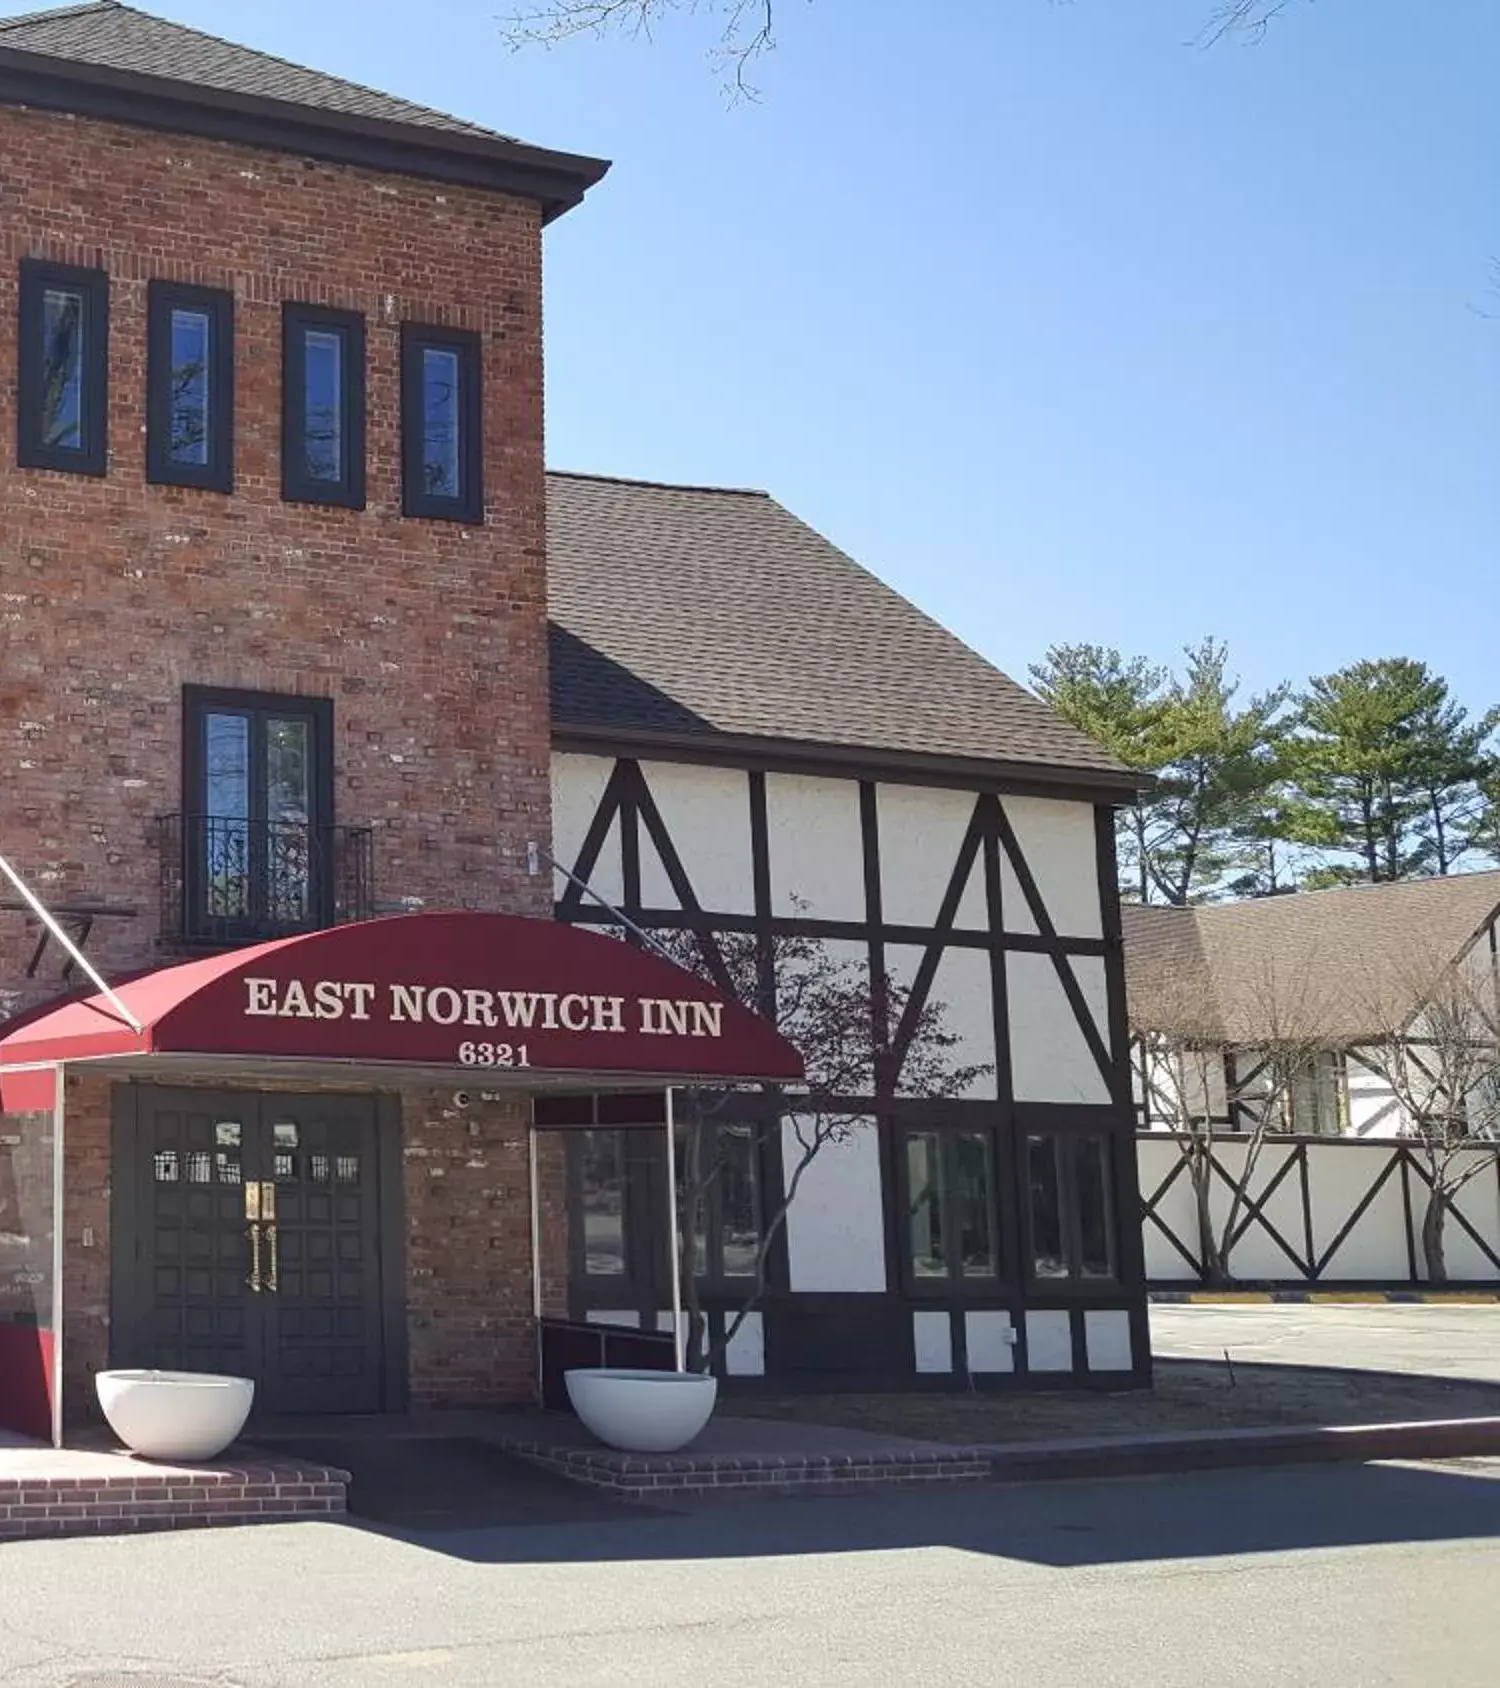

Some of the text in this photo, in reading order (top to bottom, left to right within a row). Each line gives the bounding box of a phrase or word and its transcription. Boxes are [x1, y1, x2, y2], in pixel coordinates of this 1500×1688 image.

[243, 977, 724, 1037] EAST NORWICH INN
[458, 1041, 531, 1068] 6321
